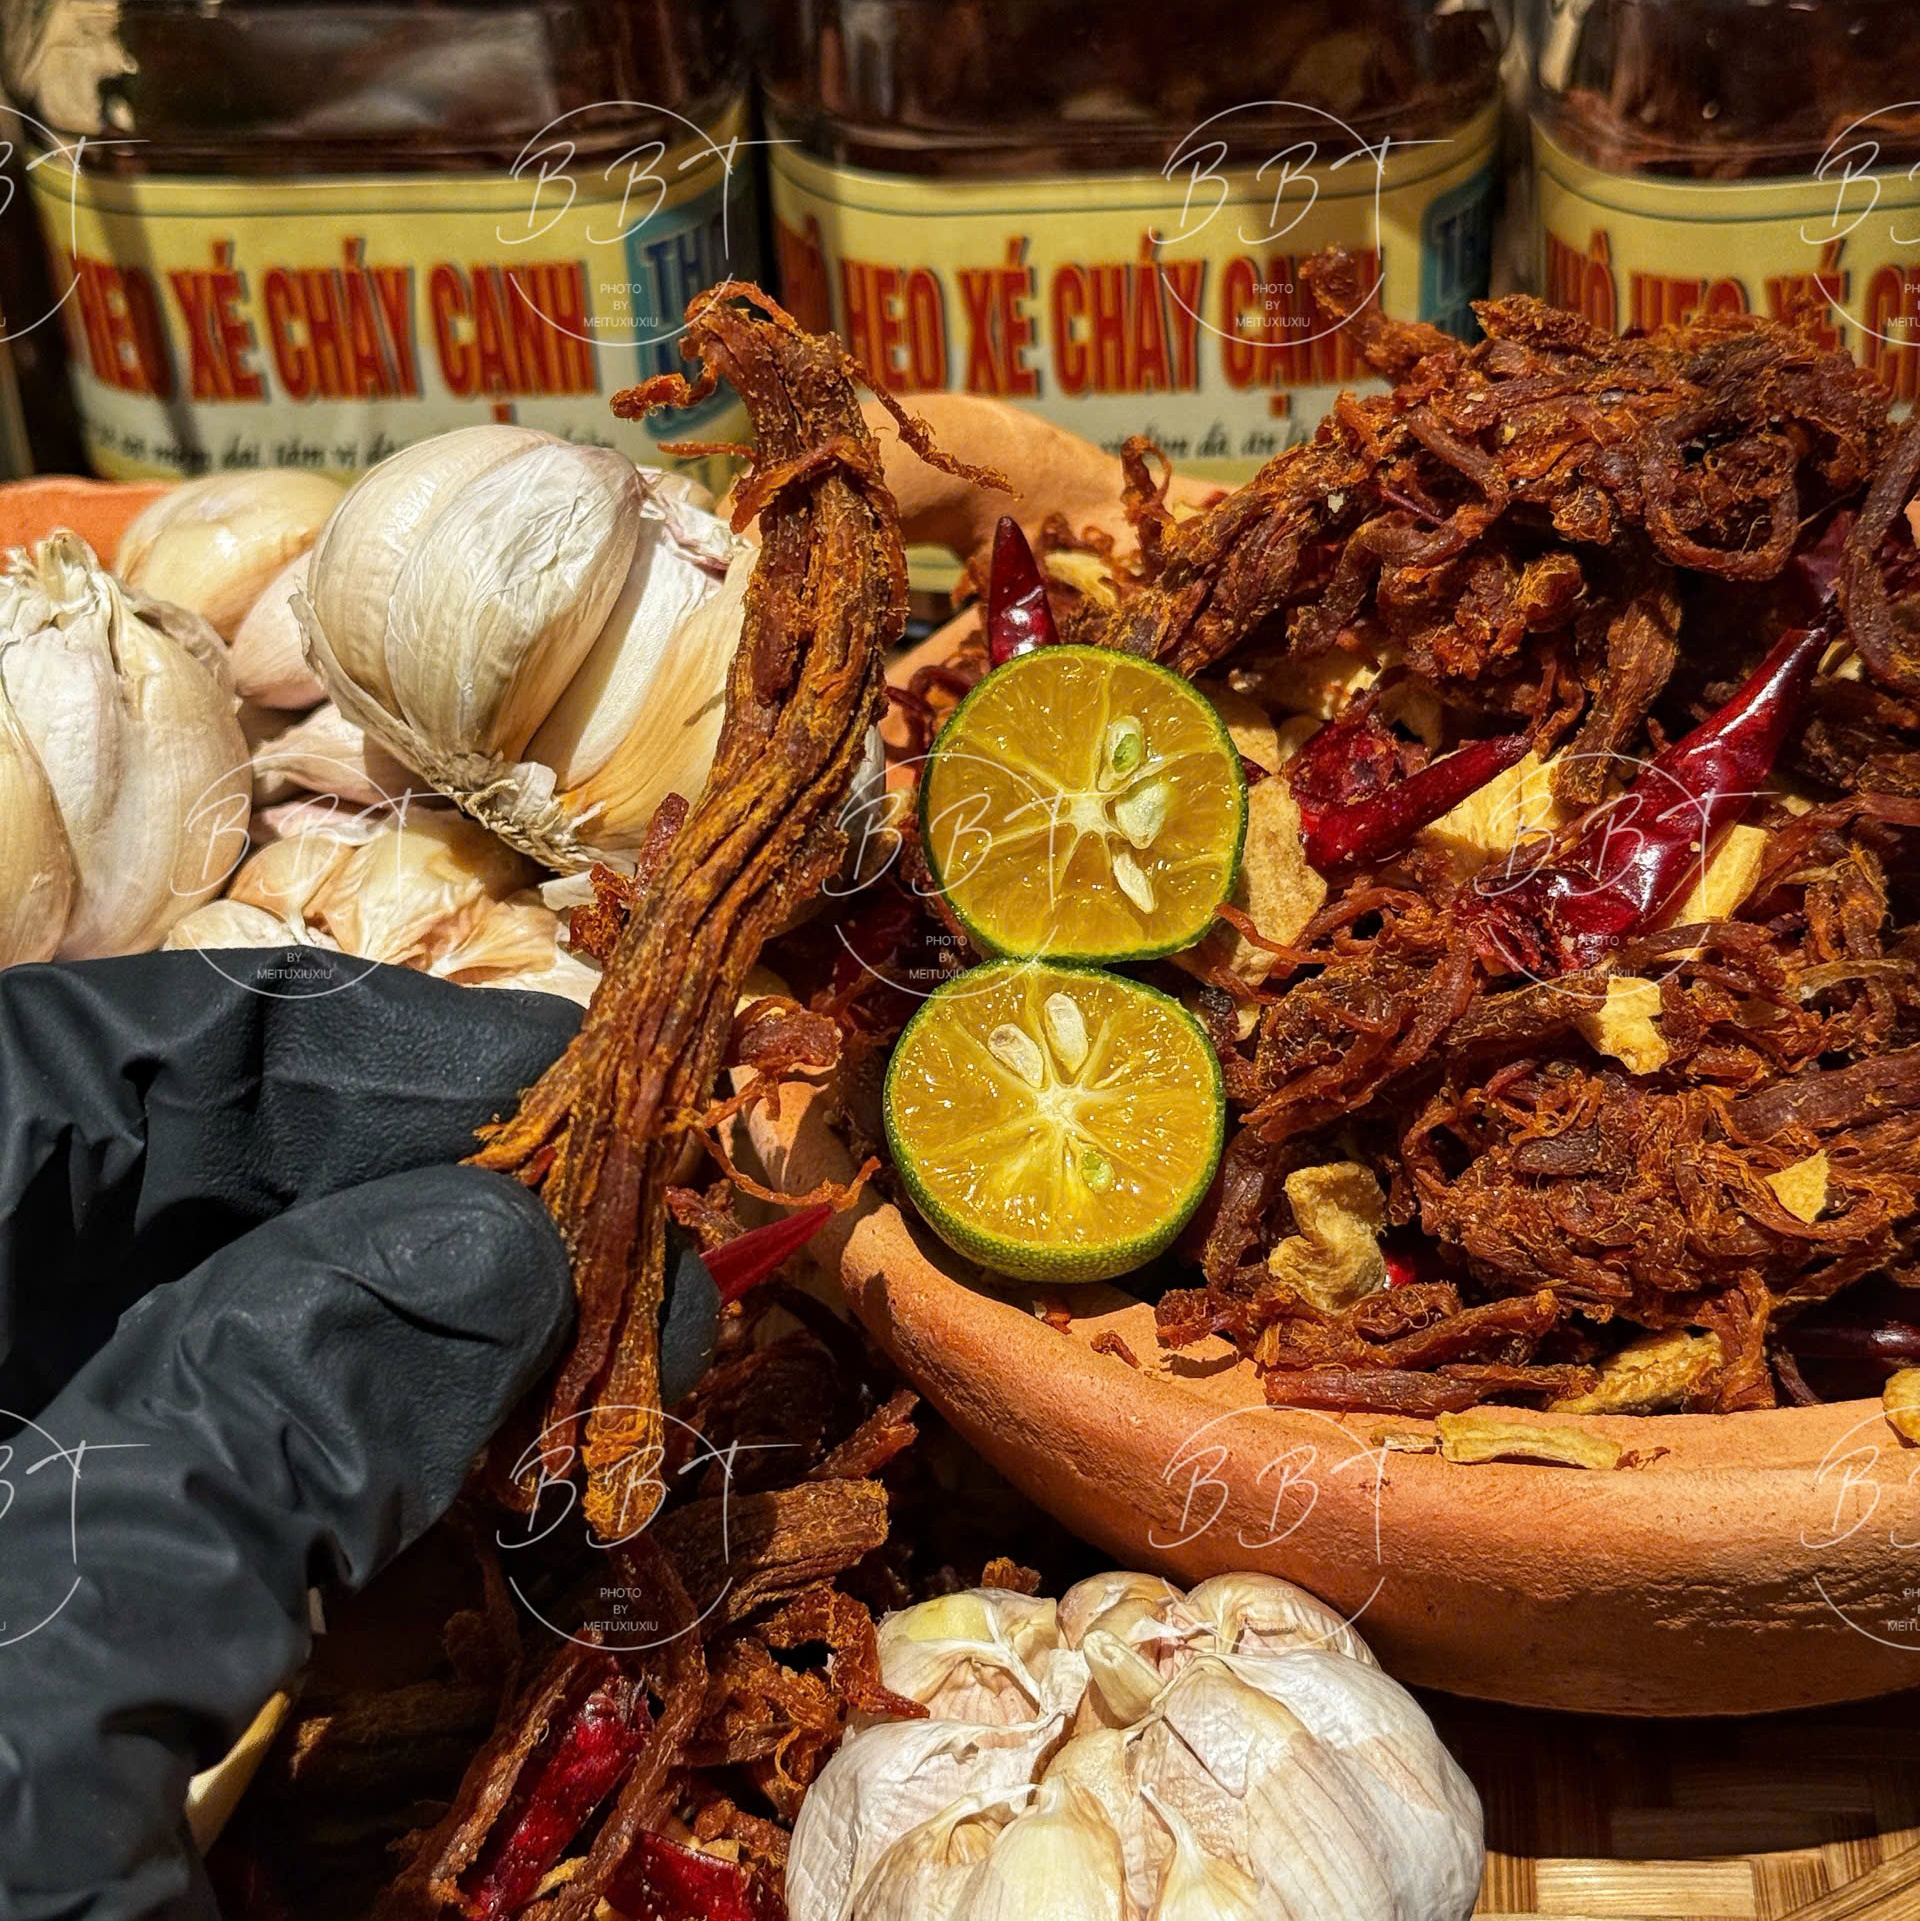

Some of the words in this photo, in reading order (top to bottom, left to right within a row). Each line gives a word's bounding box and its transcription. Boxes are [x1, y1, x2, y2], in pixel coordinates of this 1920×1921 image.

[168, 238, 267, 402] XÉ
[264, 236, 418, 401] CHÁY
[430, 260, 600, 424] CẠNH
[839, 257, 950, 391] HEO
[957, 236, 1038, 396] XÉ
[1050, 231, 1207, 393] CHÁY
